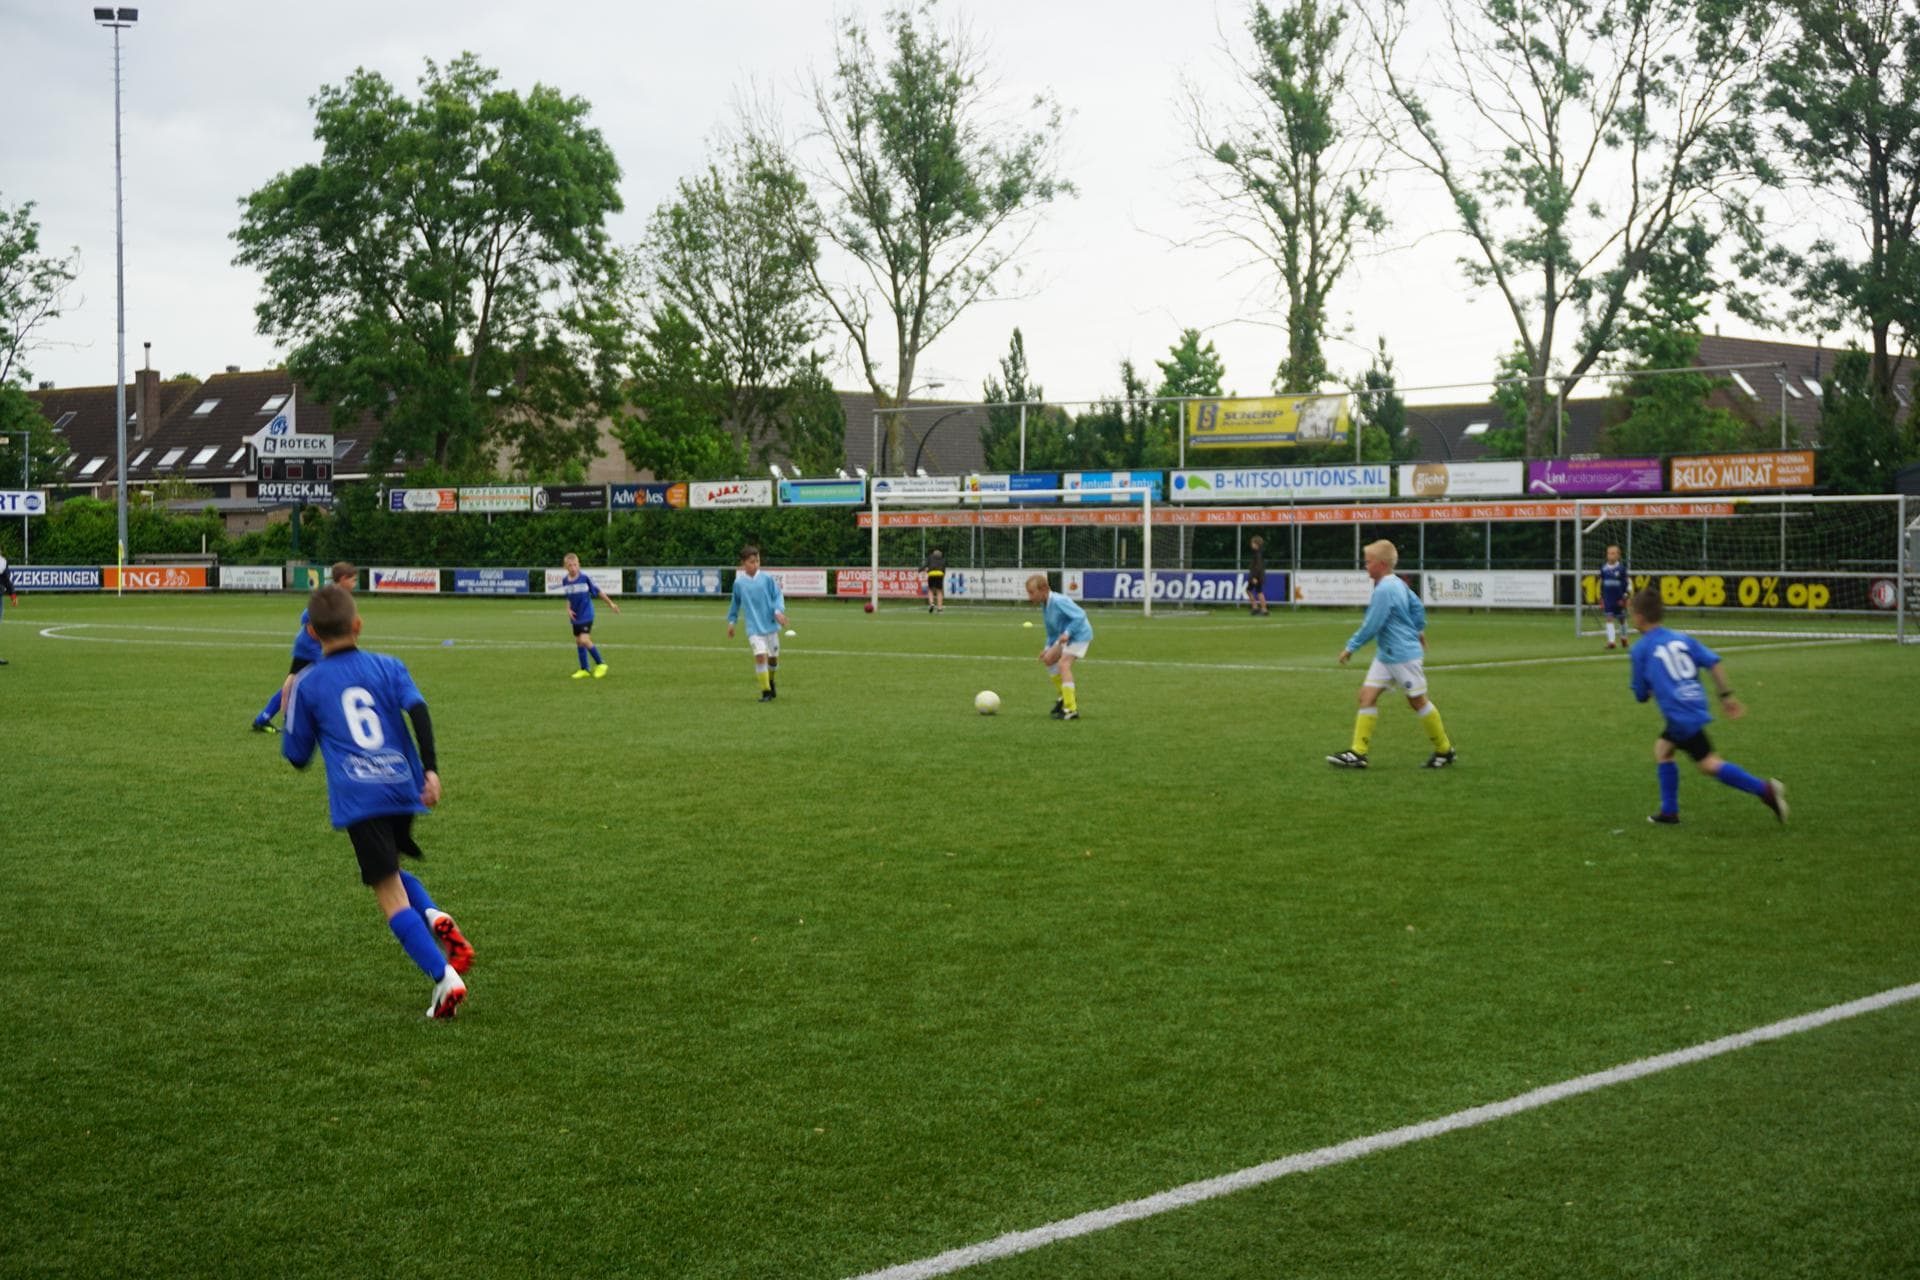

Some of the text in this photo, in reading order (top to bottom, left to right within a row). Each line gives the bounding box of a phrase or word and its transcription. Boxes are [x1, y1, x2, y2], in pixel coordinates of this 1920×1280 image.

[280, 439, 326, 449] ROTECK
[1215, 468, 1386, 489] B-KITSOLUTIONS.NL
[1674, 466, 1718, 488] BELLO
[1721, 464, 1773, 486] MURAT
[258, 484, 332, 496] ROTECK.NL
[708, 485, 740, 501] AJAX
[889, 514, 905, 525] ING
[918, 514, 934, 525] ING
[1207, 511, 1225, 521] ING
[1242, 510, 1260, 520] ING
[1314, 509, 1333, 520] ING
[1352, 508, 1371, 519] ING
[1391, 508, 1410, 519] ING
[1430, 507, 1450, 518] ING
[1472, 507, 1493, 517] ING
[1513, 506, 1534, 517] ING
[1556, 505, 1577, 516] ING
[1644, 505, 1665, 515] ING
[1690, 504, 1711, 515] ING
[121, 571, 160, 587] ING
[656, 575, 701, 587] XANTHI
[837, 570, 897, 581] AUTOBERIJF
[1114, 572, 1250, 600] Rabobank
[1660, 575, 1726, 606] BOB
[1738, 576, 1780, 607] 0%
[1786, 583, 1830, 611] op
[341, 686, 385, 752] 6
